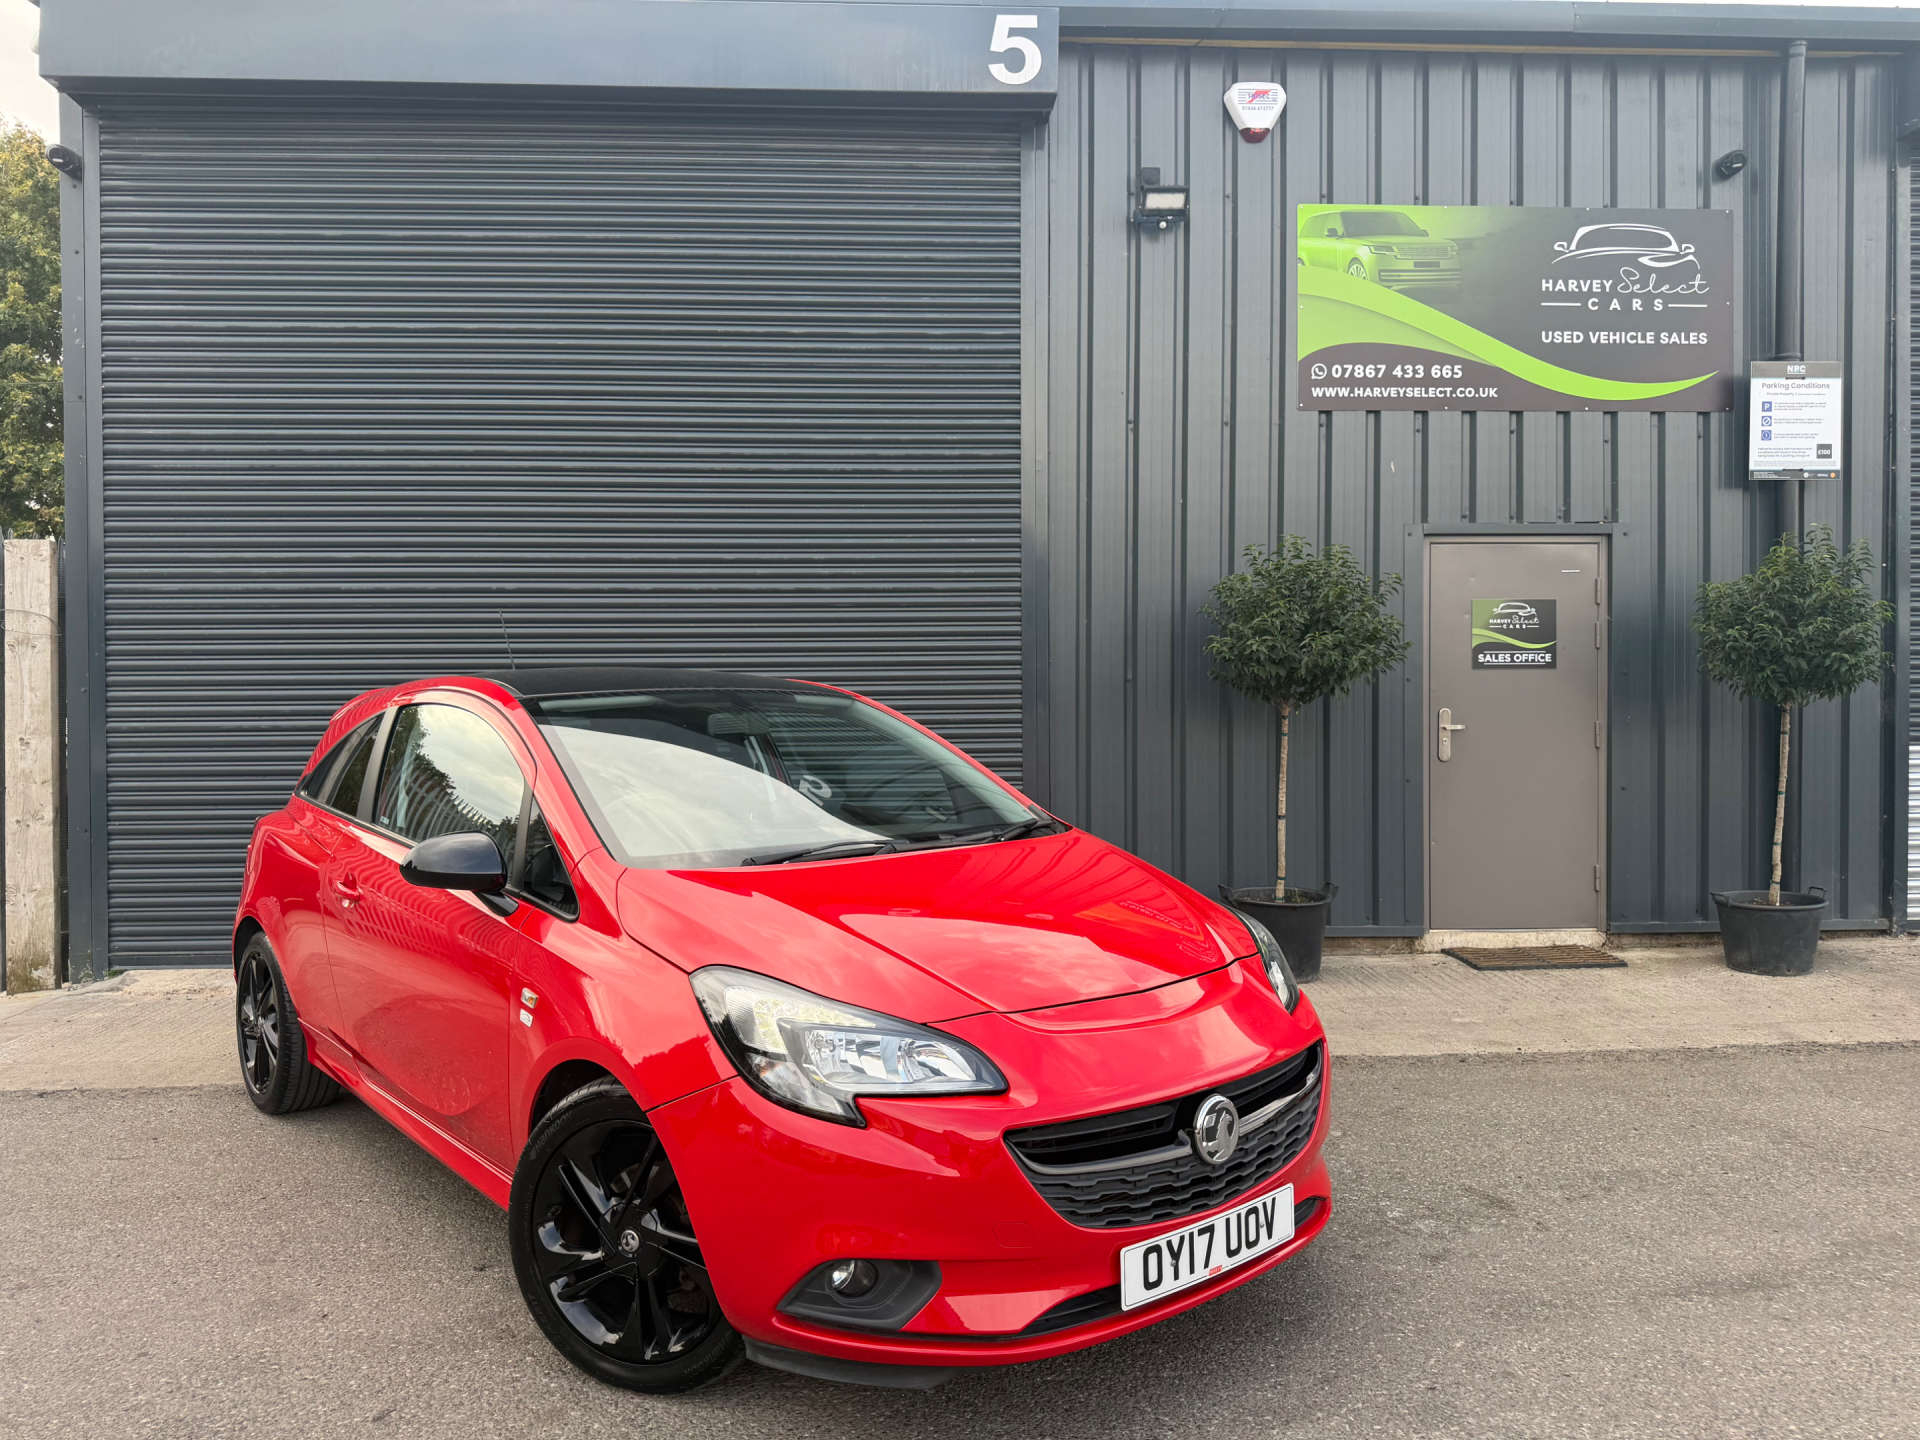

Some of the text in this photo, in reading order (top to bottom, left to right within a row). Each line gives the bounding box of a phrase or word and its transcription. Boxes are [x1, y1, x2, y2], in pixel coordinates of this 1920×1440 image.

[988, 14, 1042, 85] 5
[1541, 267, 1710, 294] HARVEY Select
[1587, 298, 1664, 311] CARS
[1541, 331, 1708, 345] USED VEHICLE SALES
[1331, 364, 1463, 379] 07867 433 665
[1311, 386, 1498, 398] WWW.HARVEYSELECT.CO.UK
[1761, 382, 1790, 391] Parking
[1512, 615, 1539, 624] Select
[1478, 653, 1552, 662] SALES OFFICE
[1143, 1196, 1277, 1291] OY17 UOV
